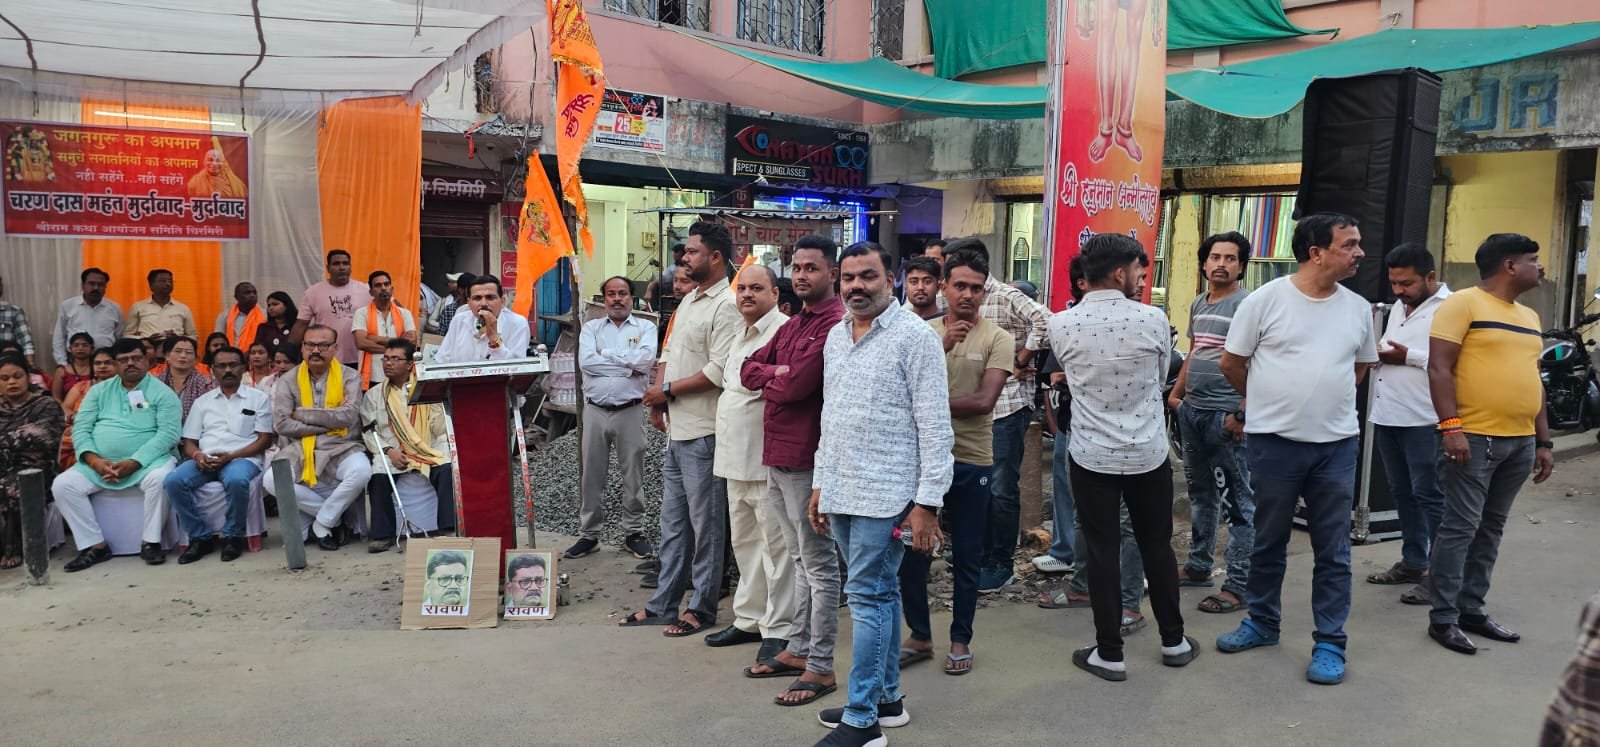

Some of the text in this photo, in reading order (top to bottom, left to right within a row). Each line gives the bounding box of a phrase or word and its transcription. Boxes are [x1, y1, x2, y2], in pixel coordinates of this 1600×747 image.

[617, 116, 631, 133] 25
[124, 134, 145, 147] का
[151, 136, 201, 150] अपमान
[144, 156, 160, 168] का
[163, 157, 199, 169] अपमान
[736, 162, 806, 178] SPECT & SUNGLASSES
[1060, 162, 1078, 207] श्री
[8, 190, 51, 212] चरण
[52, 192, 85, 213] दास
[86, 187, 124, 216] महंत
[423, 604, 464, 615] रावण
[506, 606, 546, 616] रावण
